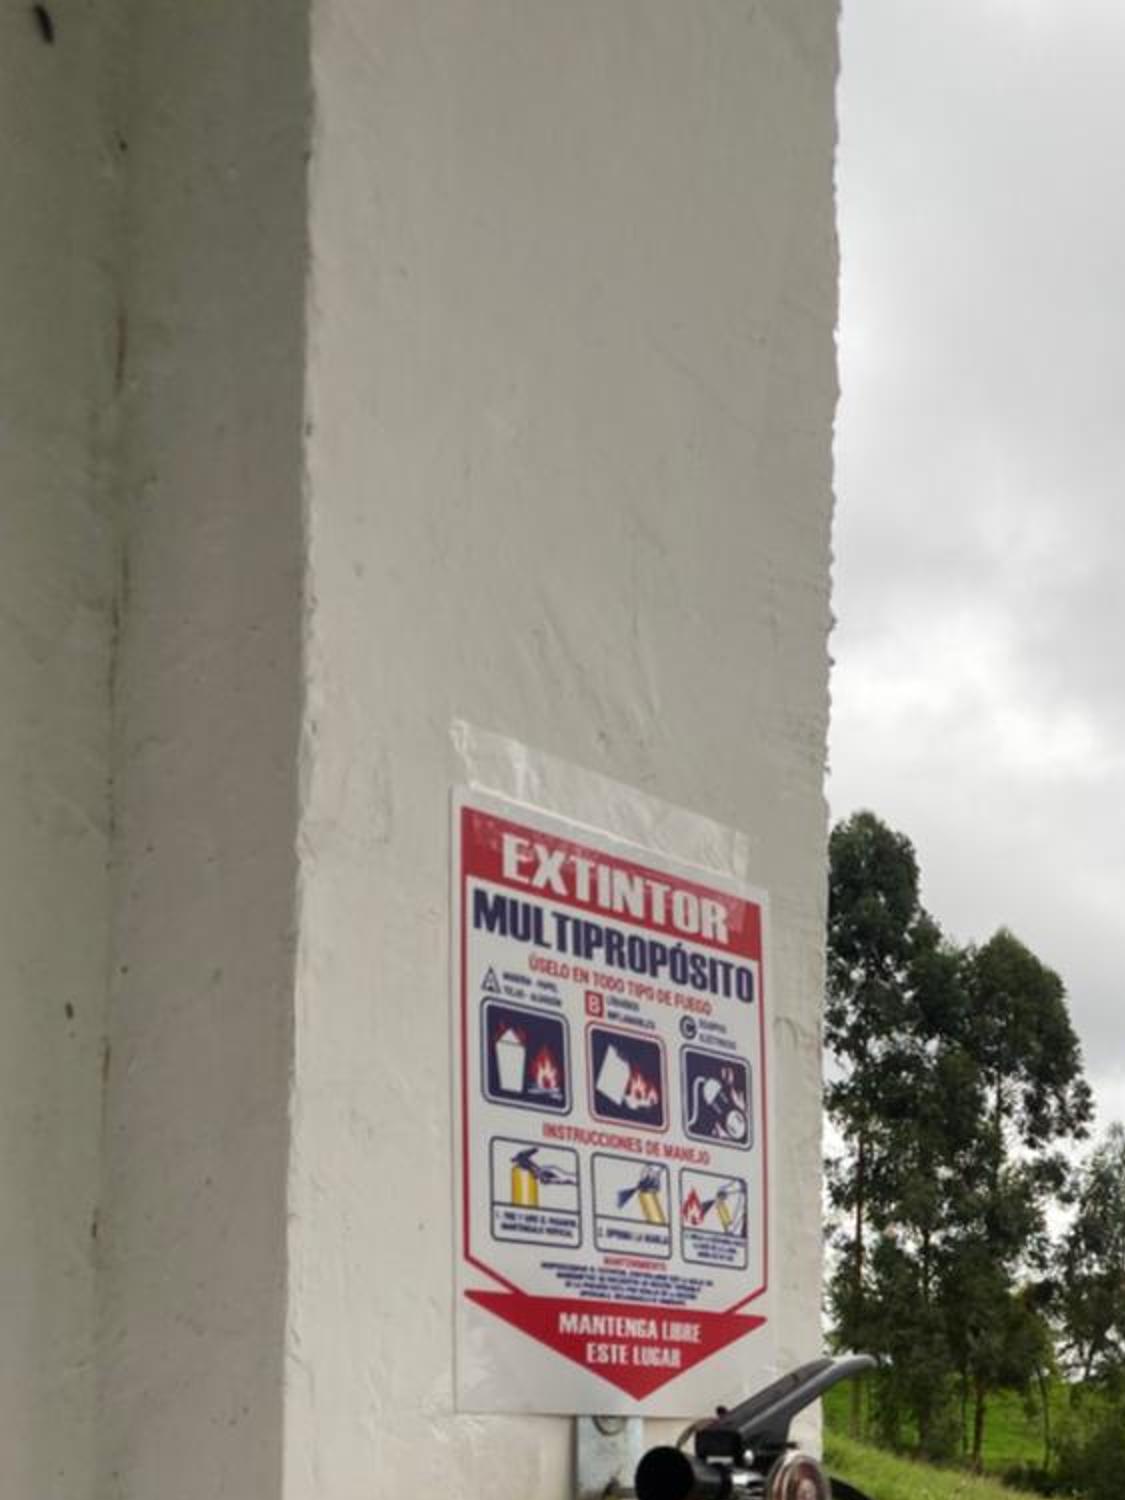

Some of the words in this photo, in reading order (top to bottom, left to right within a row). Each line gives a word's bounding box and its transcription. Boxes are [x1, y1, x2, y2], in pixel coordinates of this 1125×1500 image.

[502, 832, 729, 944] EXTINTOR
[473, 887, 754, 1003] MULTIPROPÓSITO
[573, 966, 589, 983] EN
[593, 972, 624, 993] TODO
[629, 980, 653, 1001] TIPO
[656, 989, 671, 1006] DE
[674, 992, 713, 1015] FUEGO
[588, 994, 602, 1016] B
[543, 1122, 642, 1152] INSTRUCCIONES
[645, 1139, 661, 1156] DE
[663, 1144, 711, 1165] MANEJO
[559, 1312, 658, 1340] MANTENGA
[662, 1320, 701, 1343] LIBRE
[586, 1342, 629, 1365] ESTE
[632, 1346, 681, 1368] LUGAR
